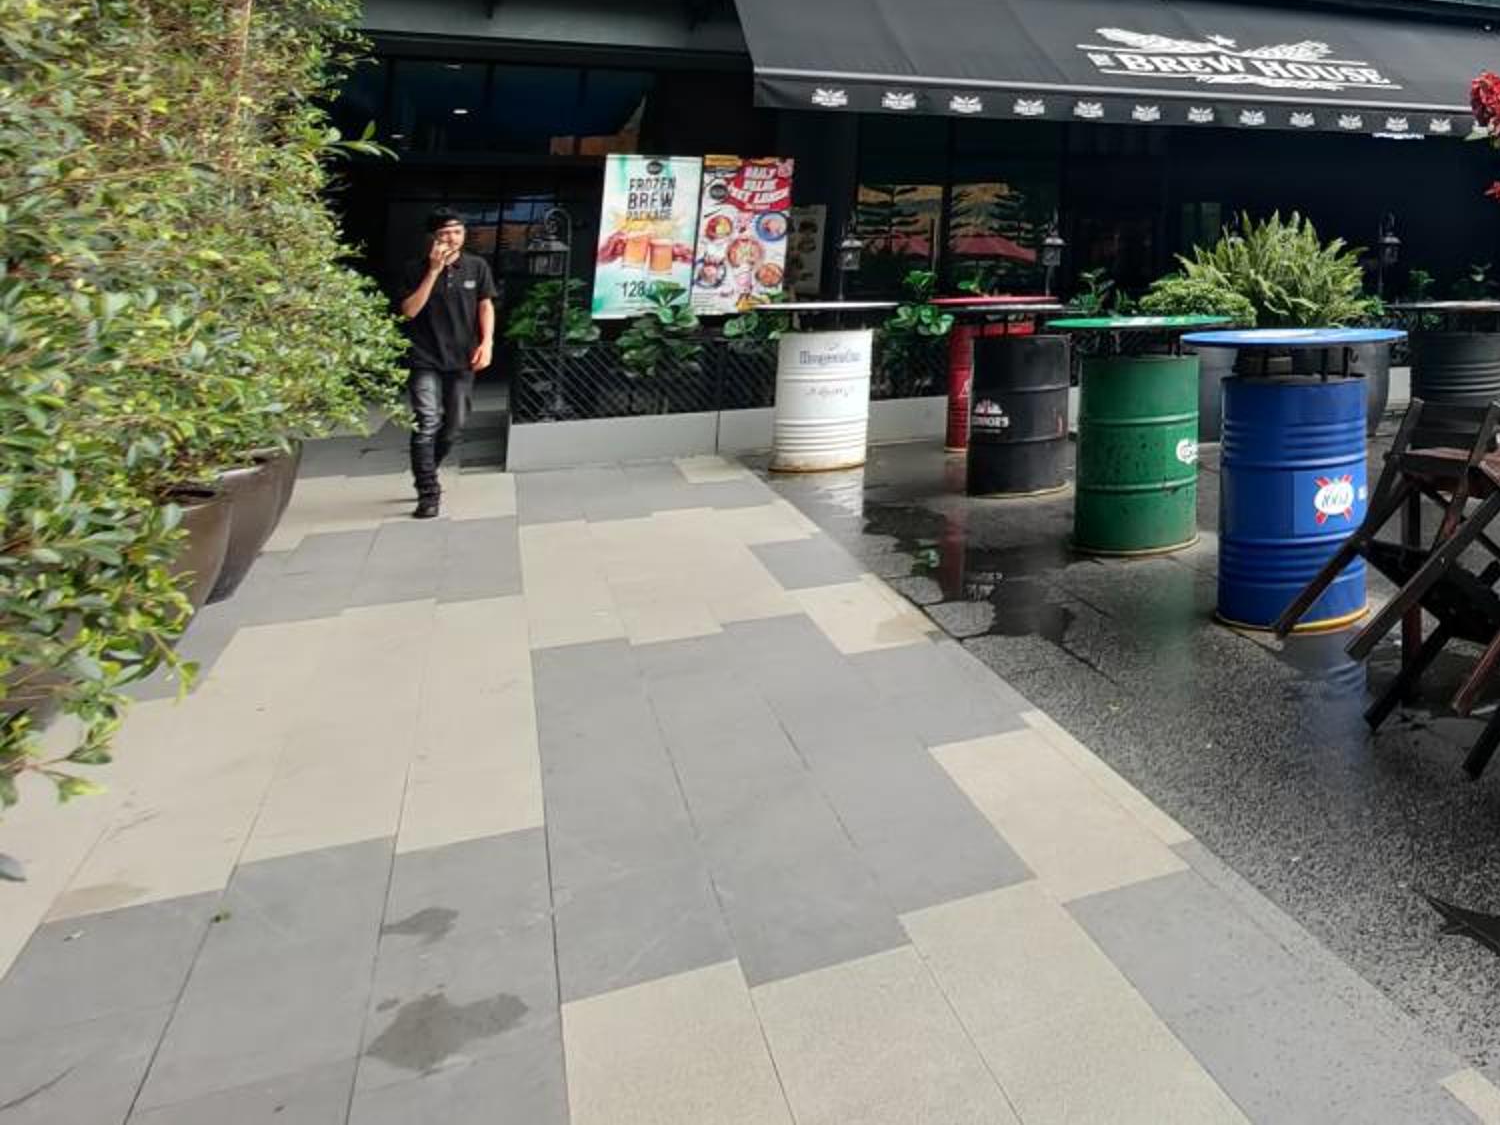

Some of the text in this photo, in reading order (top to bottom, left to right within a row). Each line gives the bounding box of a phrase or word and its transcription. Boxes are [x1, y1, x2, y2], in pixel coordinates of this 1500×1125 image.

[1115, 53, 1245, 72] BREW
[1250, 60, 1391, 83] HOUSE
[629, 177, 675, 190] FROZEN
[628, 190, 673, 210] BREW
